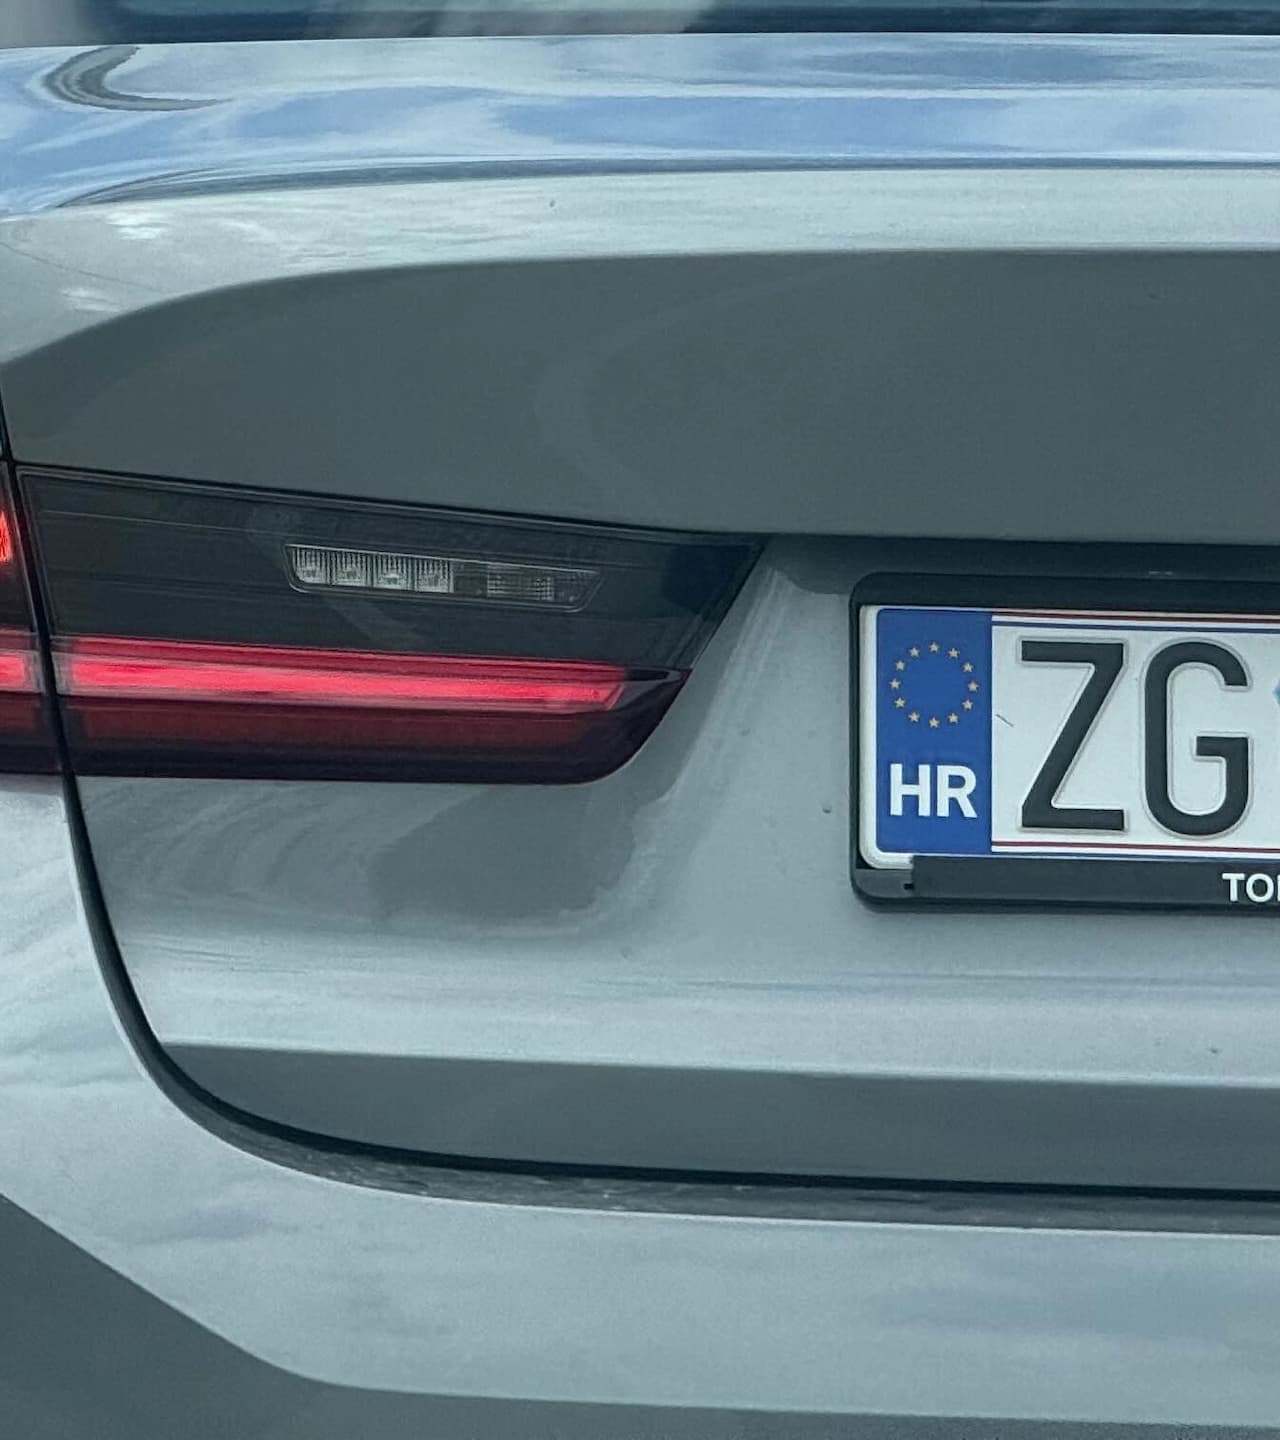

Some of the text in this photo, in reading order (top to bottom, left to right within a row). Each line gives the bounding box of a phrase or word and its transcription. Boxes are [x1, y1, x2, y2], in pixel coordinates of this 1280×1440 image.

[1021, 640, 1249, 836] ZG
[889, 763, 978, 819] HR
[1222, 873, 1280, 903] TO
